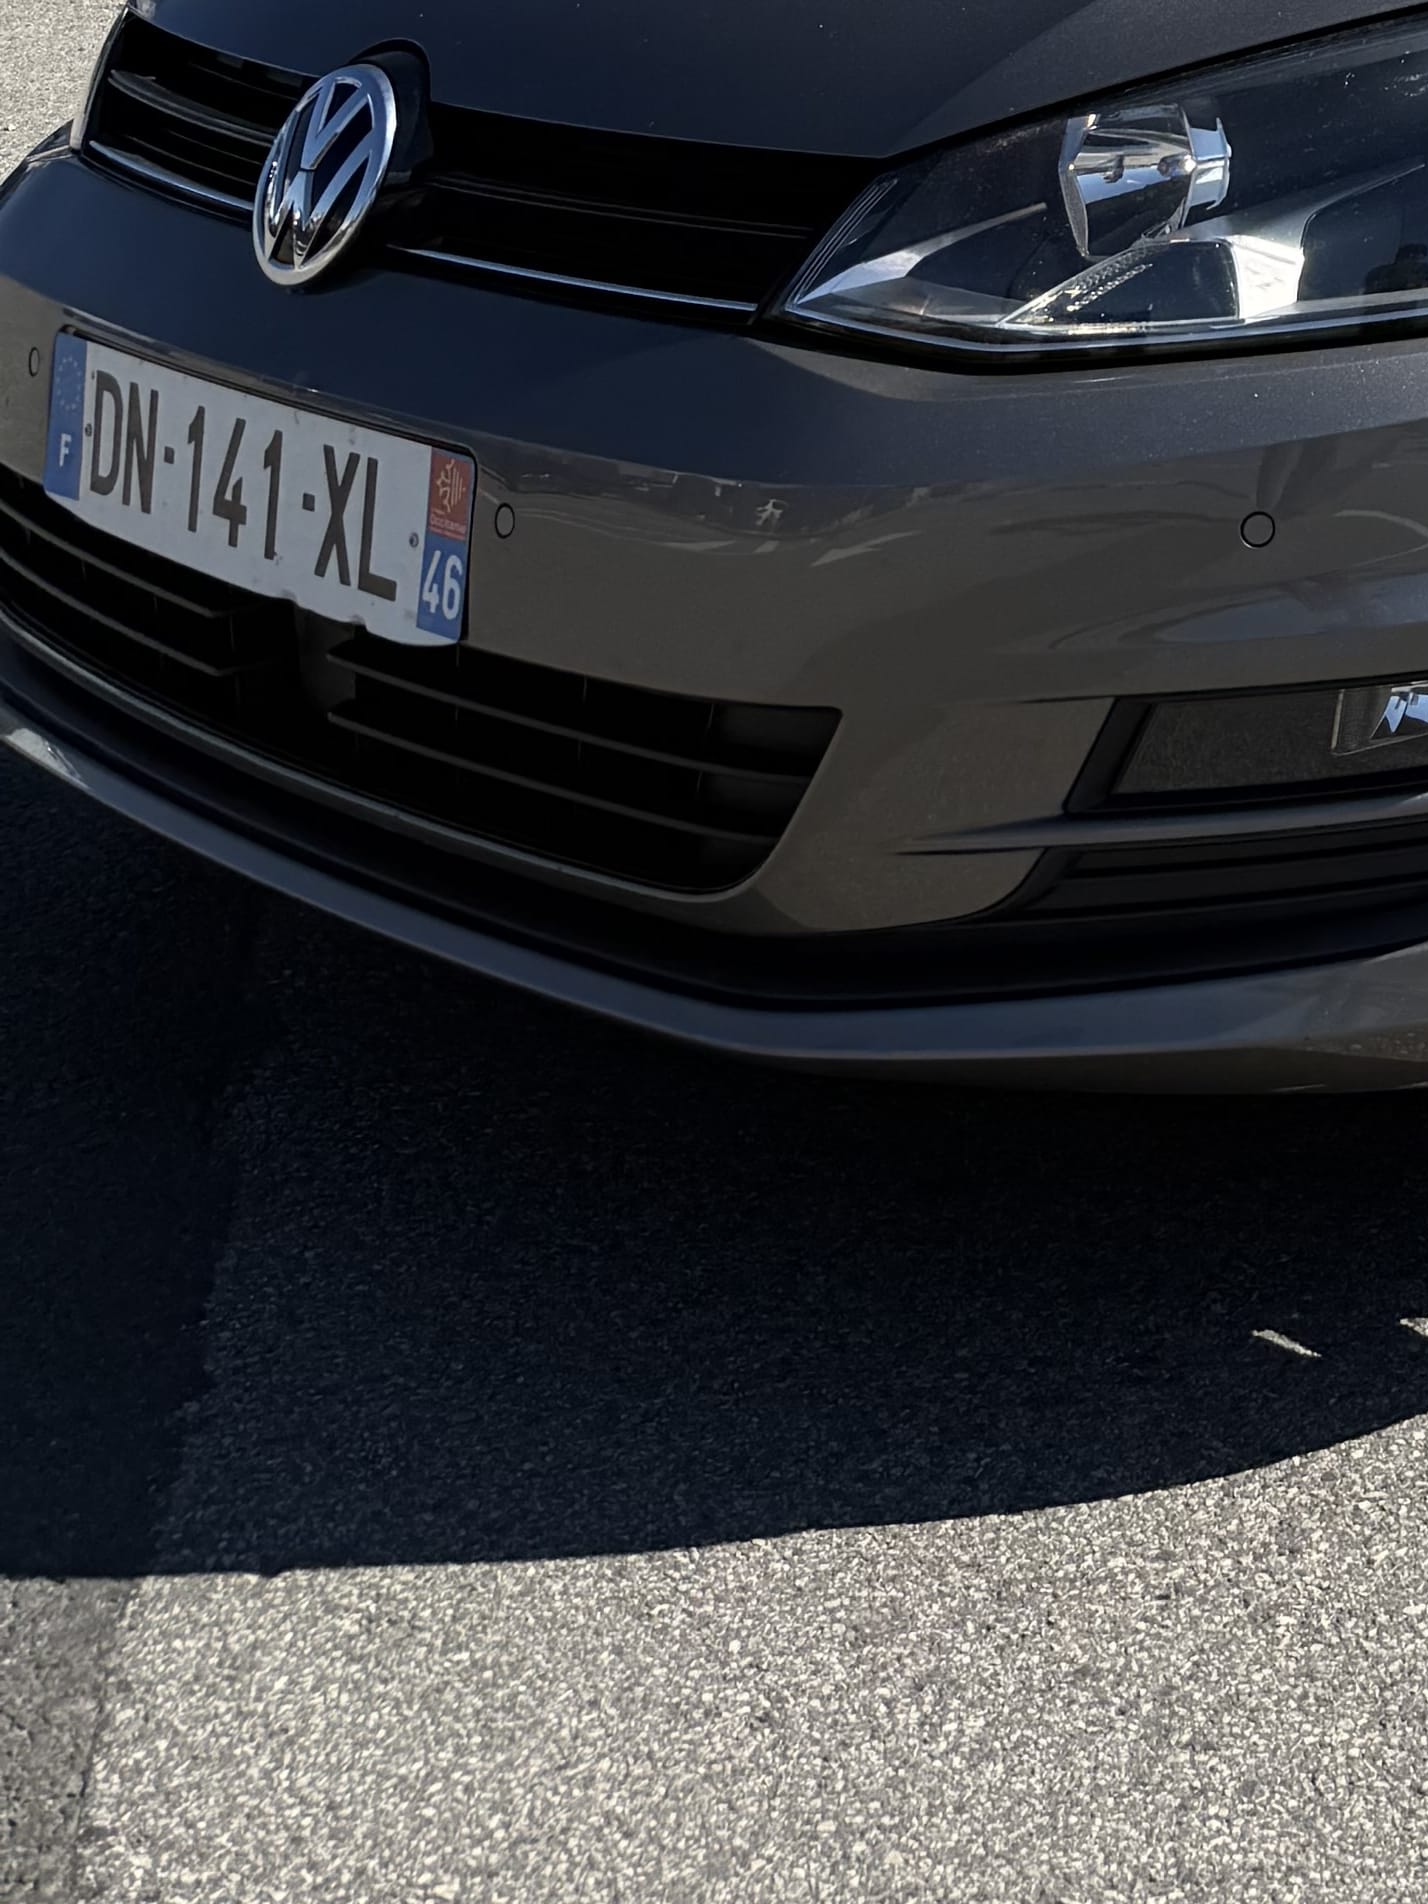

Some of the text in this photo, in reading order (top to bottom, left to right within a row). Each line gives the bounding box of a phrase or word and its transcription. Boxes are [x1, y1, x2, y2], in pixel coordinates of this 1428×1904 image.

[59, 433, 72, 467] F
[90, 370, 397, 602] DN-141-XL
[422, 550, 463, 620] 46
